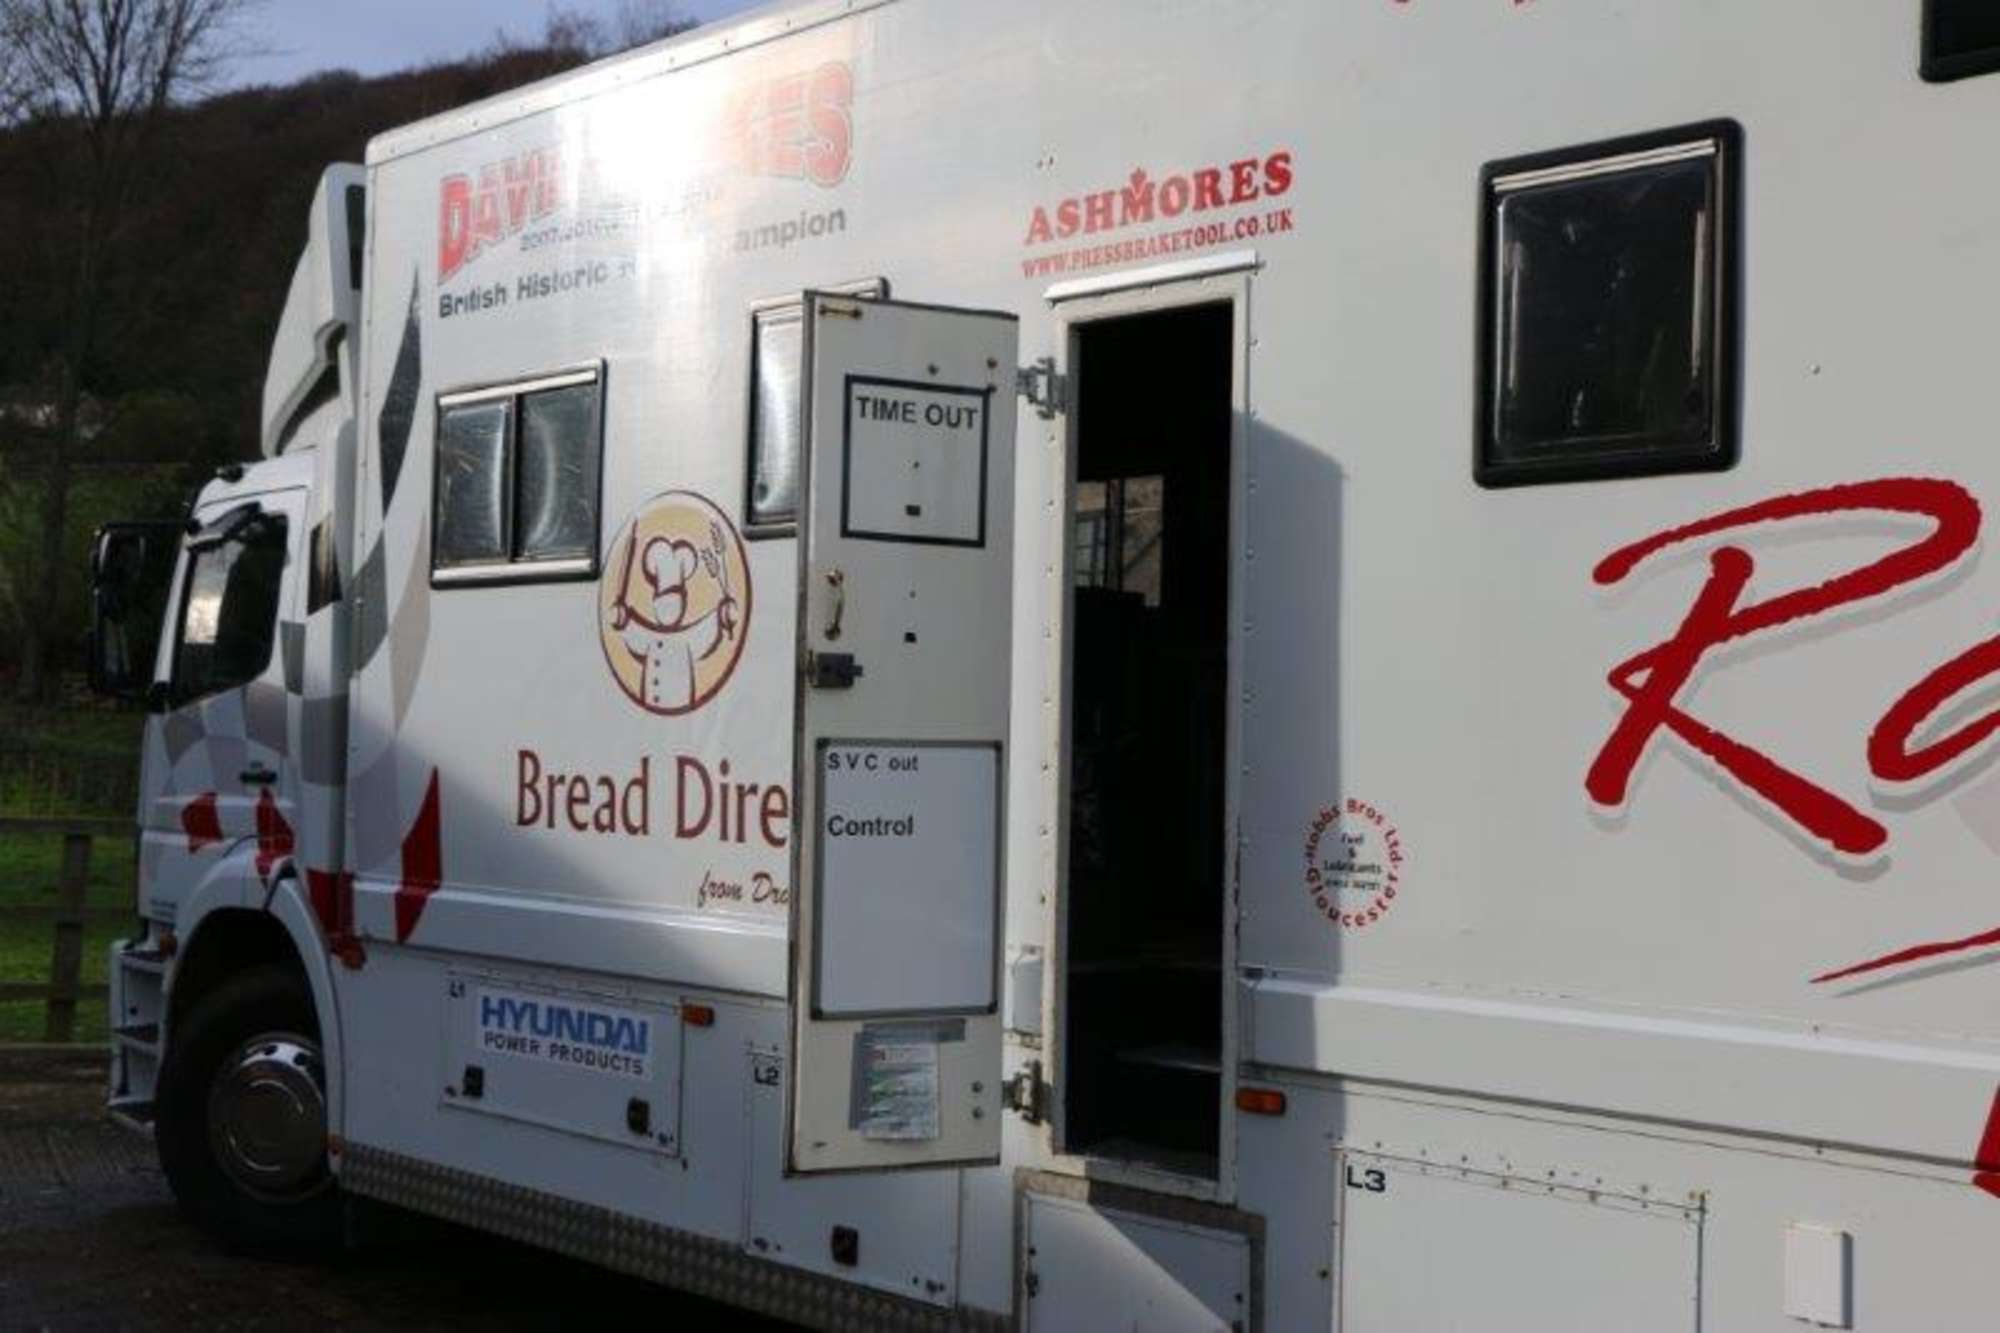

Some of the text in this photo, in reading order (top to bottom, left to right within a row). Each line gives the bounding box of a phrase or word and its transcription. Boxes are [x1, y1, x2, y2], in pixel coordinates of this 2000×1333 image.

[1025, 152, 1293, 246] ASHMORES
[735, 206, 846, 253] ampion
[1022, 208, 1293, 279] WWW.PRESSBRAKETOOL.CO.UK
[439, 283, 507, 318] British
[517, 261, 607, 301] Historic
[856, 396, 978, 429] TIME OUT
[889, 755, 919, 771] out
[516, 750, 789, 847] Bread Dire
[1346, 798, 1384, 825] Bros
[828, 815, 914, 837] Control
[698, 869, 742, 908] from
[481, 995, 648, 1054] HYUNDAI
[484, 1031, 643, 1076] POWER PRODUCTS
[753, 1066, 780, 1087] L2
[1346, 1164, 1387, 1193] L3
